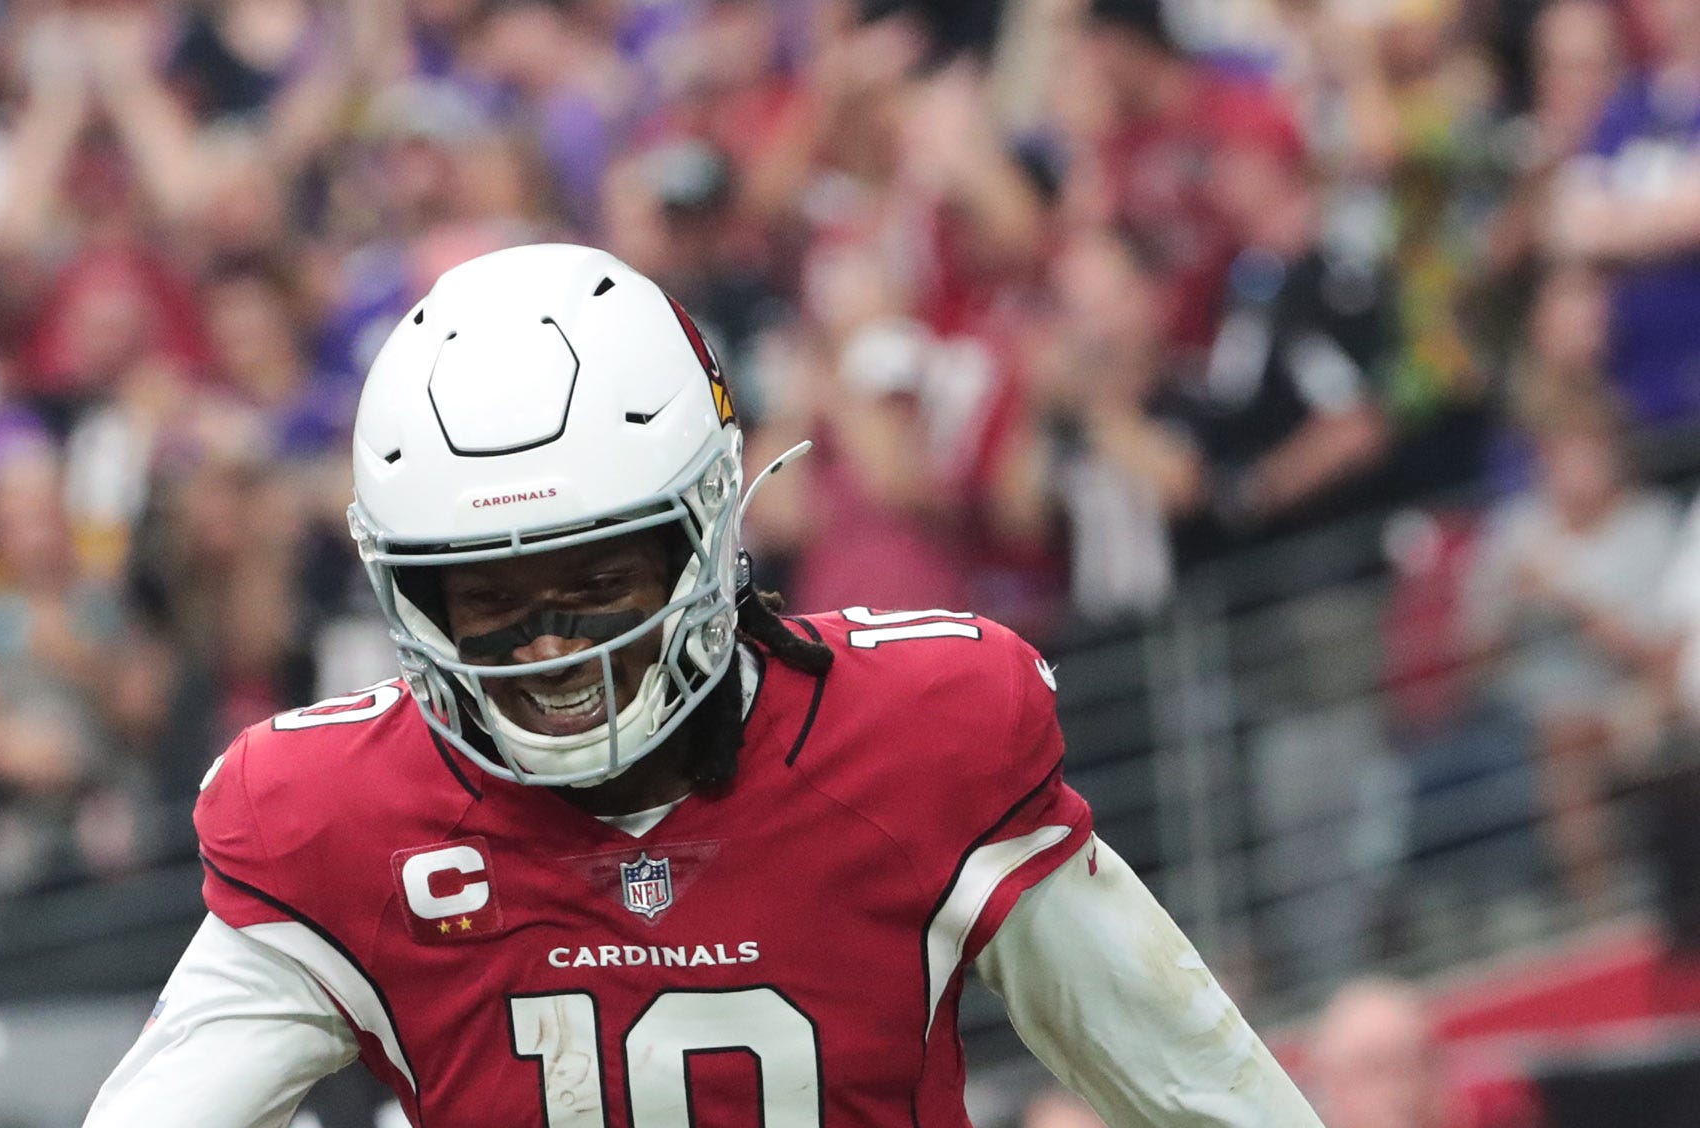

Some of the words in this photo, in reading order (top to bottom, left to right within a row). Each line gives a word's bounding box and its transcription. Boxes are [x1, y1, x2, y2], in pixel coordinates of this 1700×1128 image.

[471, 487, 558, 509] CARDINALS
[401, 844, 491, 920] C
[630, 881, 666, 907] NFL
[547, 940, 762, 969] CARDINALS
